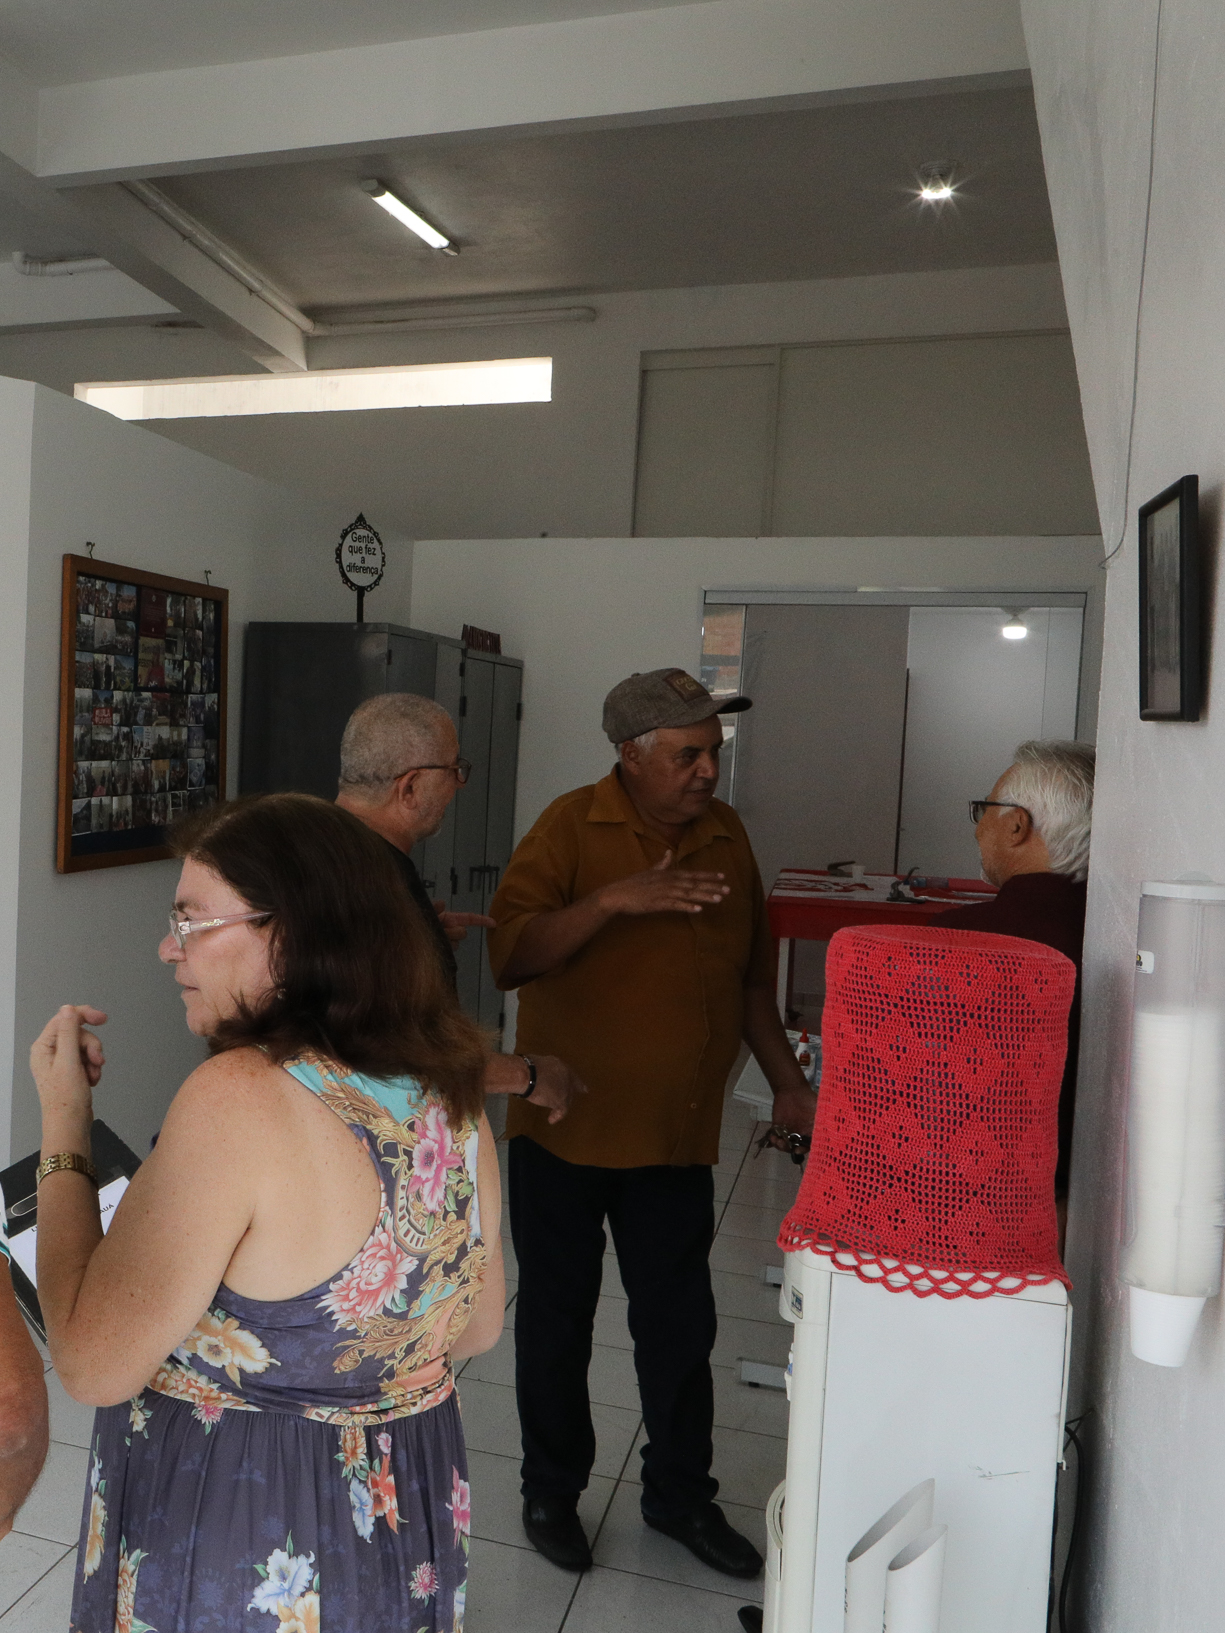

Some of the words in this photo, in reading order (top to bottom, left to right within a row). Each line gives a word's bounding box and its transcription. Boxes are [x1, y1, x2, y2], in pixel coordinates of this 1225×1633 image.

[351, 532, 374, 544] Gente
[348, 545, 363, 556] que
[365, 544, 376, 555] fez
[361, 556, 365, 564] a
[346, 562, 378, 576] diferença
